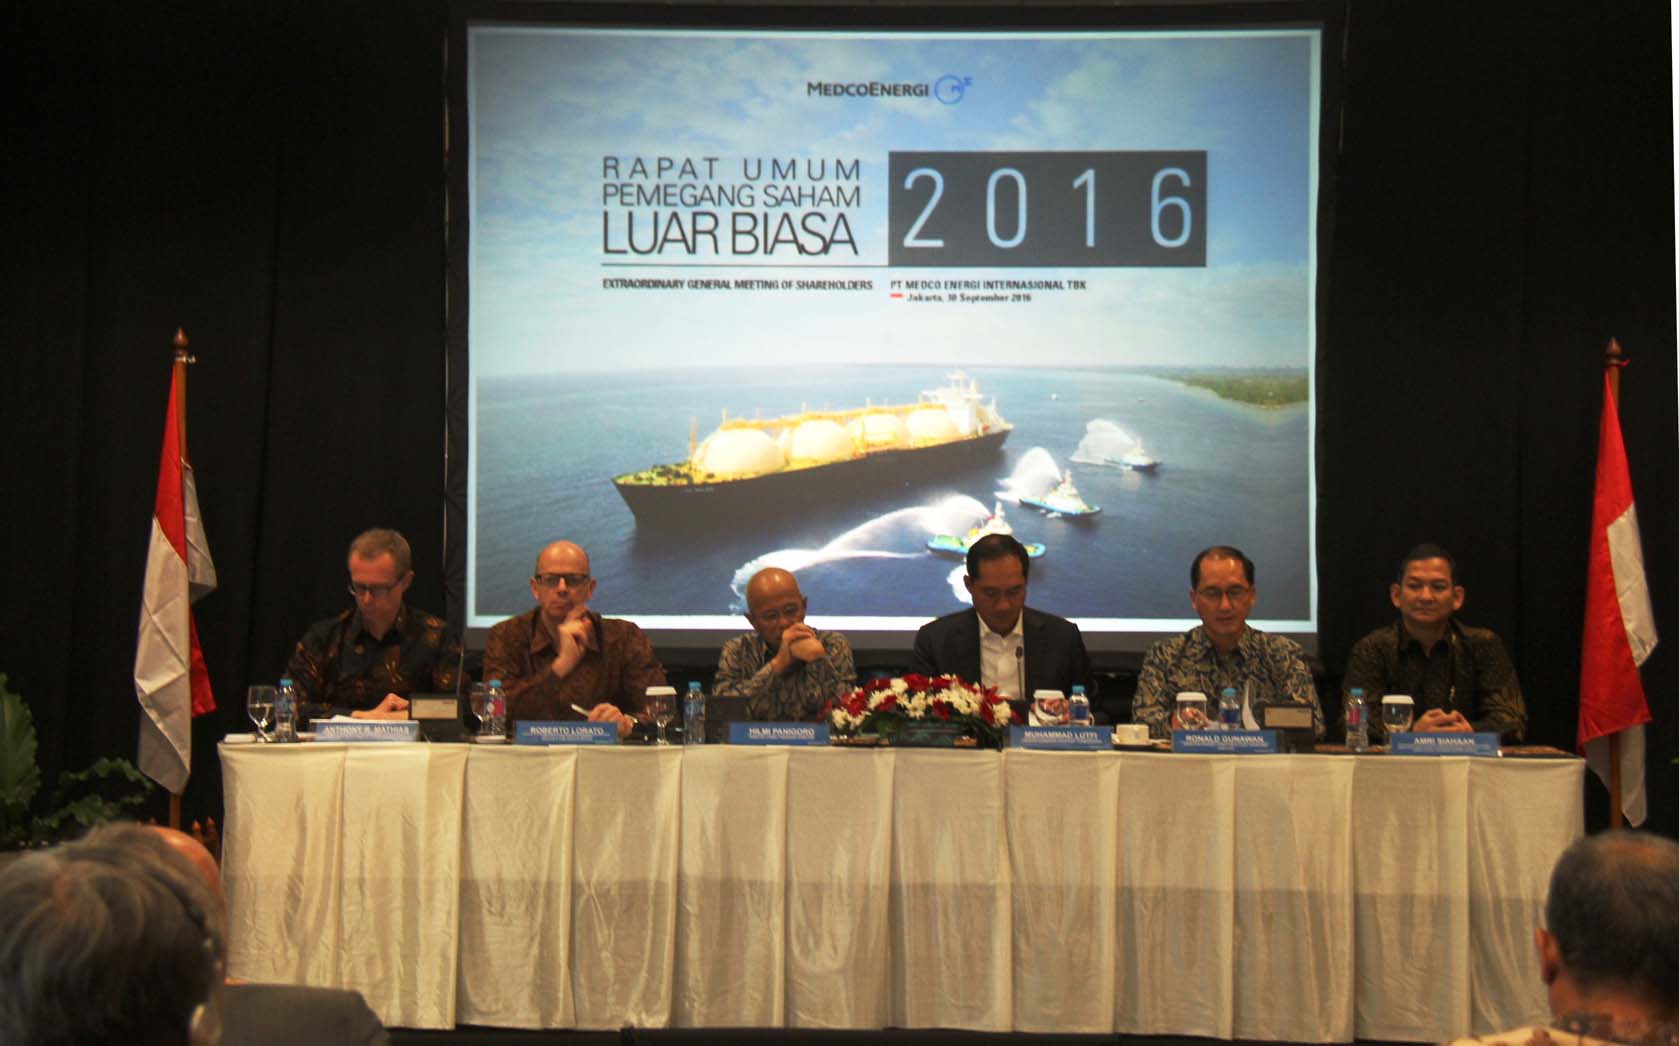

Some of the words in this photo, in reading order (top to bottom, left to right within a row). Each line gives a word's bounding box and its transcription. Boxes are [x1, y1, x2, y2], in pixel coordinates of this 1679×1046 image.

[602, 156, 720, 180] RAPAT
[743, 158, 861, 181] UMUM
[602, 183, 755, 207] PEMEGANG
[762, 185, 861, 208] SAHAM
[903, 167, 1193, 248] 2016
[602, 211, 720, 255] LUAR
[732, 212, 859, 256] BIASA
[602, 278, 685, 290] EXTRAORDINARY
[687, 278, 732, 290] GENERAL
[734, 279, 780, 290] MEETING
[781, 280, 795, 290] OF
[796, 280, 873, 291] SHAREHOLDERS
[890, 280, 902, 290] PT
[905, 280, 942, 290] MEDCO
[944, 280, 980, 290] ENERGI
[983, 280, 1064, 290] INTERNASIONAL
[1066, 280, 1087, 290] TBK
[960, 293, 1009, 303] September
[1011, 293, 1032, 303] 2016
[530, 726, 569, 736] ROBERTO
